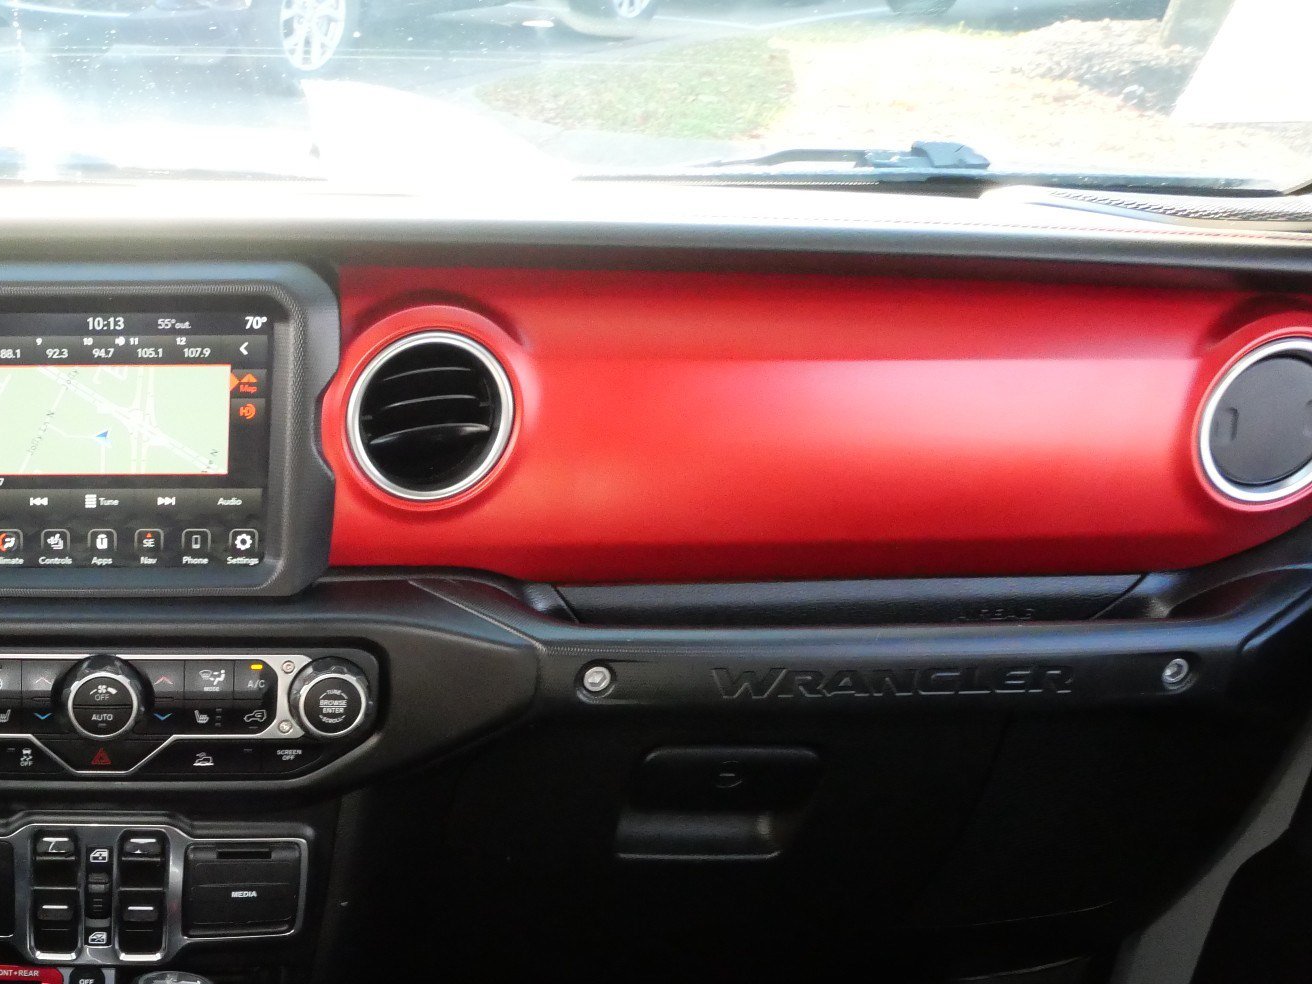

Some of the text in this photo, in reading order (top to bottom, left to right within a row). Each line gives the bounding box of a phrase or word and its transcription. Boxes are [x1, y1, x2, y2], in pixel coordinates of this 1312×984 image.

[87, 316, 125, 331] 10:13
[244, 316, 268, 330] 70°
[36, 337, 43, 346] 9
[129, 337, 139, 345] 11
[175, 337, 187, 345] 12
[0, 349, 21, 359] 88.1
[45, 349, 69, 359] 92.3
[92, 349, 115, 358] 94.7
[137, 348, 163, 358] 105.1
[183, 347, 211, 358] 107.9
[98, 497, 120, 506] Tune
[217, 497, 243, 506] Audio
[142, 539, 156, 548] SE
[38, 556, 73, 566] Controls
[91, 557, 113, 566] Apps
[140, 556, 157, 565] Nav
[182, 556, 209, 565] Phone
[226, 556, 260, 567] Settings
[247, 680, 266, 689] A/C
[711, 666, 1074, 699] WRANGLER
[94, 693, 111, 701] OFF
[91, 713, 114, 721] AUTO
[231, 890, 258, 898] MEDIA
